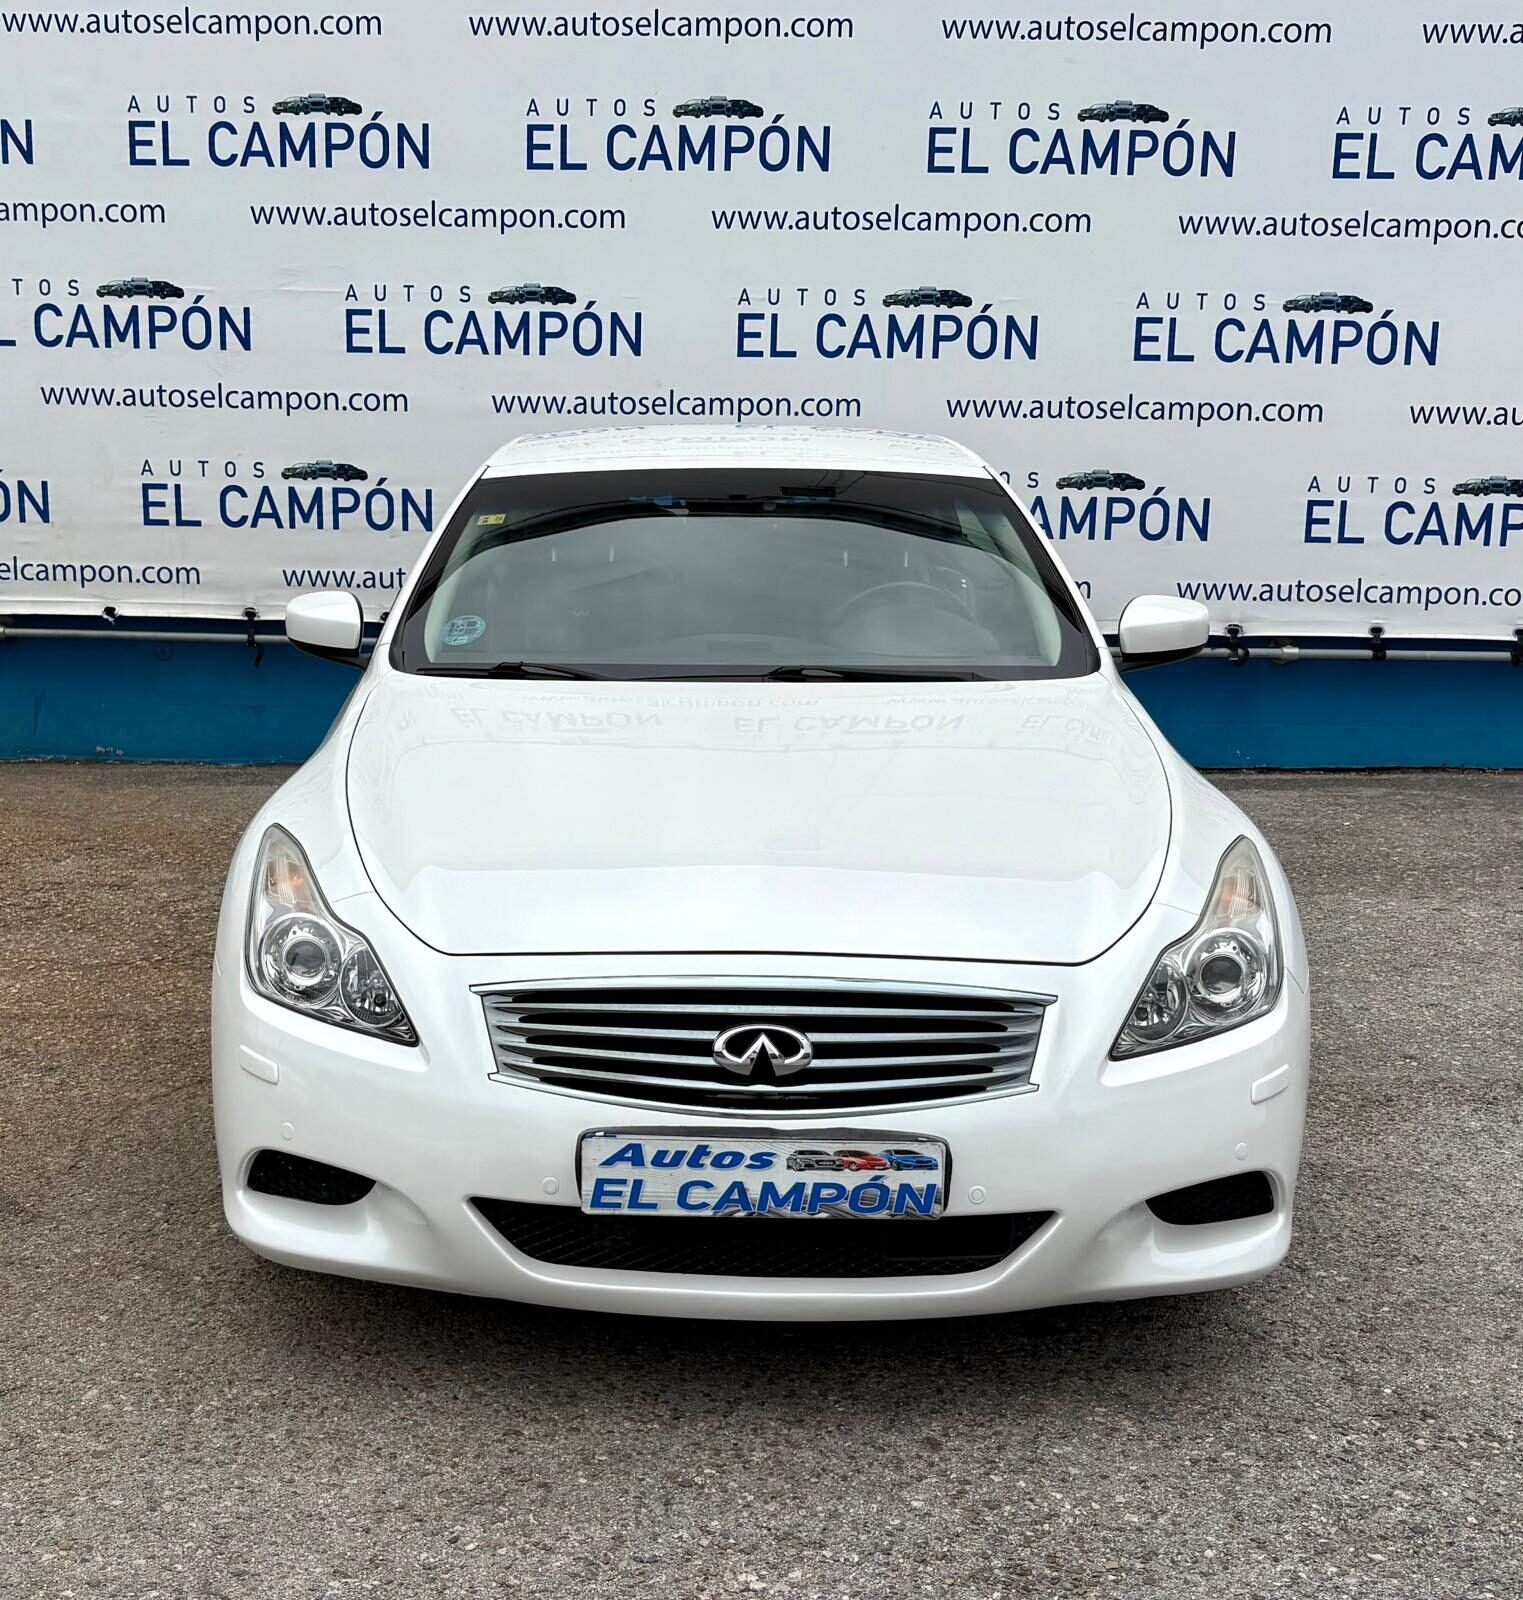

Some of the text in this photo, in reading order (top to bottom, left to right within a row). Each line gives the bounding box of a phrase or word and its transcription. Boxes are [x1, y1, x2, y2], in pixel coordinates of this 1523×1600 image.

[1, 6, 382, 42] www.autoselcampon.com
[468, 8, 853, 45] www.autoselcampon.com
[941, 12, 1332, 50] www.autoselcampon.com
[127, 95, 255, 114] AUTOS
[526, 98, 656, 117] AUTOS
[928, 100, 1060, 121] AUTOS
[1336, 106, 1471, 126] AUTOS
[128, 110, 430, 170] EL CAMPÓN
[526, 113, 831, 173] EL CAMPÓN
[927, 118, 1236, 178] EL CAMPÓN
[1331, 132, 1523, 181] EL CAM
[249, 199, 626, 235] www.autoselcampon.com
[711, 203, 1091, 239] www.autoselcampon.com
[344, 283, 471, 303] AUTOS
[737, 287, 866, 307] AUTOS
[1135, 291, 1266, 312] AUTOS
[33, 294, 252, 352] CAMPÓN
[345, 300, 642, 357] EL CAMPÓN
[736, 303, 1039, 361] EL CAMPÓN
[1133, 308, 1440, 366] EL CAMPÓN
[40, 382, 409, 417] www.autoselcampon.com
[491, 388, 861, 423] www.autoselcampon.com
[946, 393, 1323, 428] www.autoselcampon.com
[140, 459, 265, 479] AUTOS
[1307, 475, 1436, 495] AUTOS
[141, 477, 433, 533] EL CAMPÓN
[1303, 499, 1523, 547] EL CAMP
[282, 567, 407, 590] www.aut
[1176, 577, 1522, 612] www.autoselcampon.co
[598, 1142, 777, 1170] Autos
[589, 1175, 938, 1215] EL CAMPÓN
